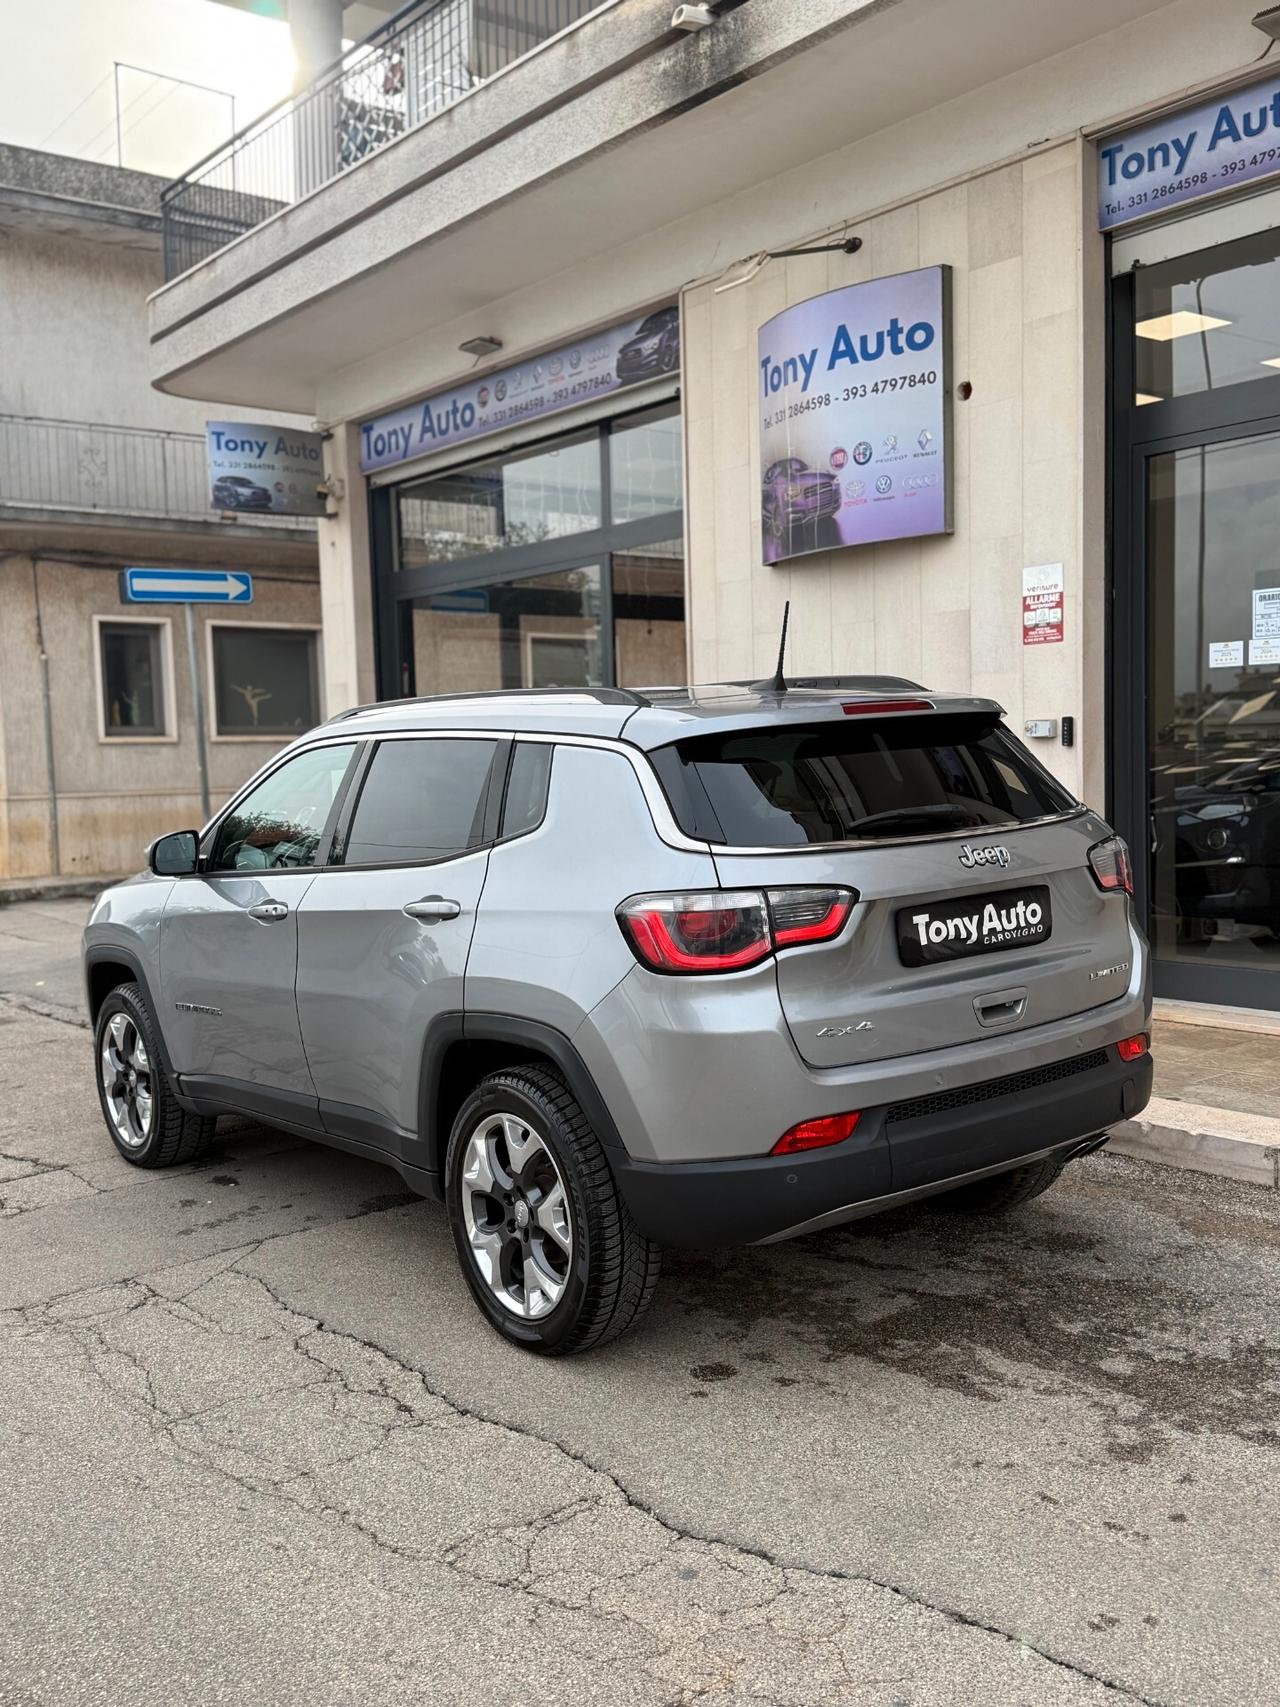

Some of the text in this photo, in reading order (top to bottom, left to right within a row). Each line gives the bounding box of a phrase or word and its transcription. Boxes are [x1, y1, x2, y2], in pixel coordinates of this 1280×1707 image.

[1101, 130, 1198, 186] Tony
[1105, 202, 1125, 216] Tel.
[1128, 193, 1149, 208] 331
[1151, 172, 1208, 200] 2864598
[1221, 159, 1246, 177] 393
[761, 317, 936, 398] Tony Auto
[552, 387, 570, 403] 393
[571, 371, 613, 396] 4797840
[775, 409, 787, 424] 331
[788, 393, 832, 419] 2864598
[843, 384, 868, 402] 393
[871, 370, 938, 396] 4797840
[362, 399, 475, 460] Tony Auto
[211, 431, 320, 462] Tony Auto
[1025, 593, 1061, 605] ALLARME
[1026, 583, 1059, 593] verisure
[958, 844, 1011, 869] Jeep
[983, 924, 1044, 945] CAROVIGNO
